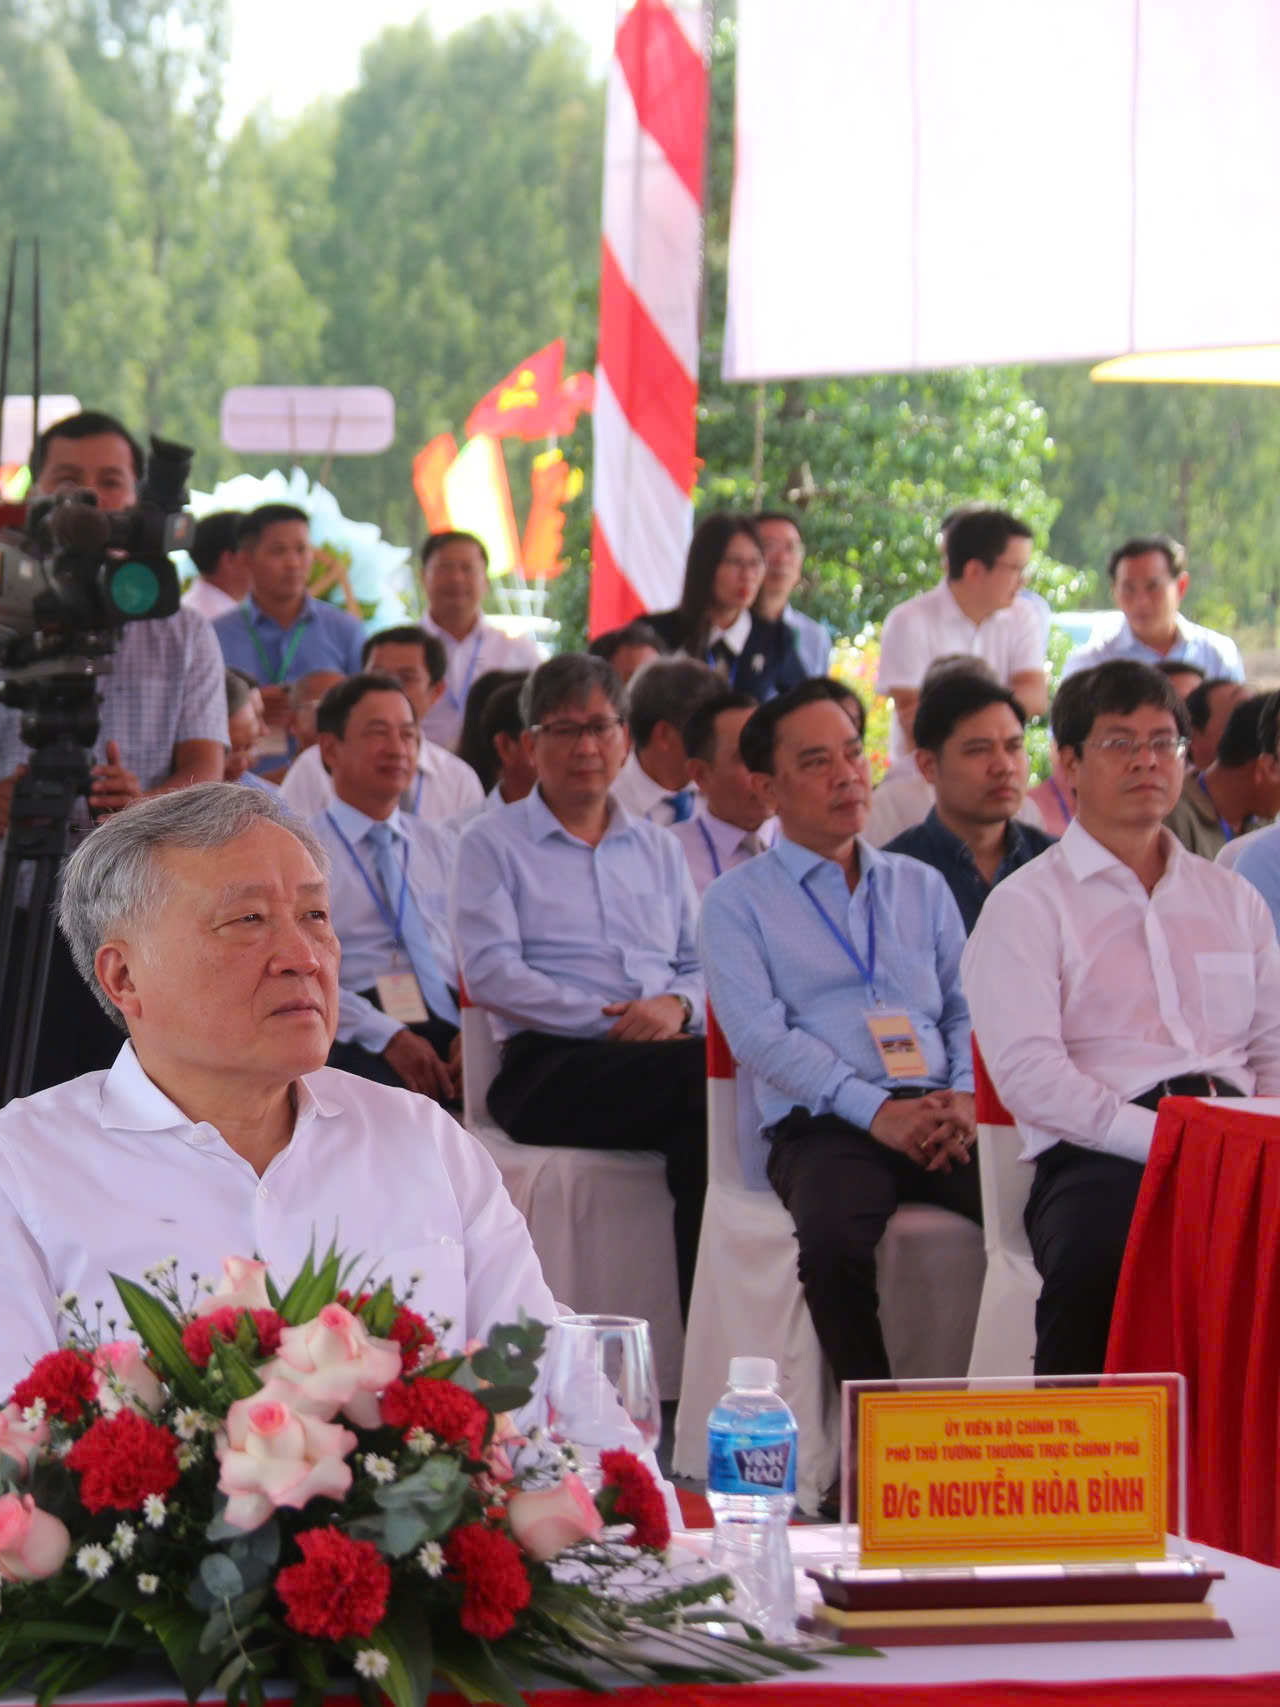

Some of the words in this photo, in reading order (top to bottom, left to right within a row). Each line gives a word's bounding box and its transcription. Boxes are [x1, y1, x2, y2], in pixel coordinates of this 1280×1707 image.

[882, 1482, 921, 1519] Đ/c
[928, 1467, 1024, 1518] NGUYỄN
[1032, 1469, 1080, 1515] HÒA
[1088, 1469, 1144, 1513] BÌNH
